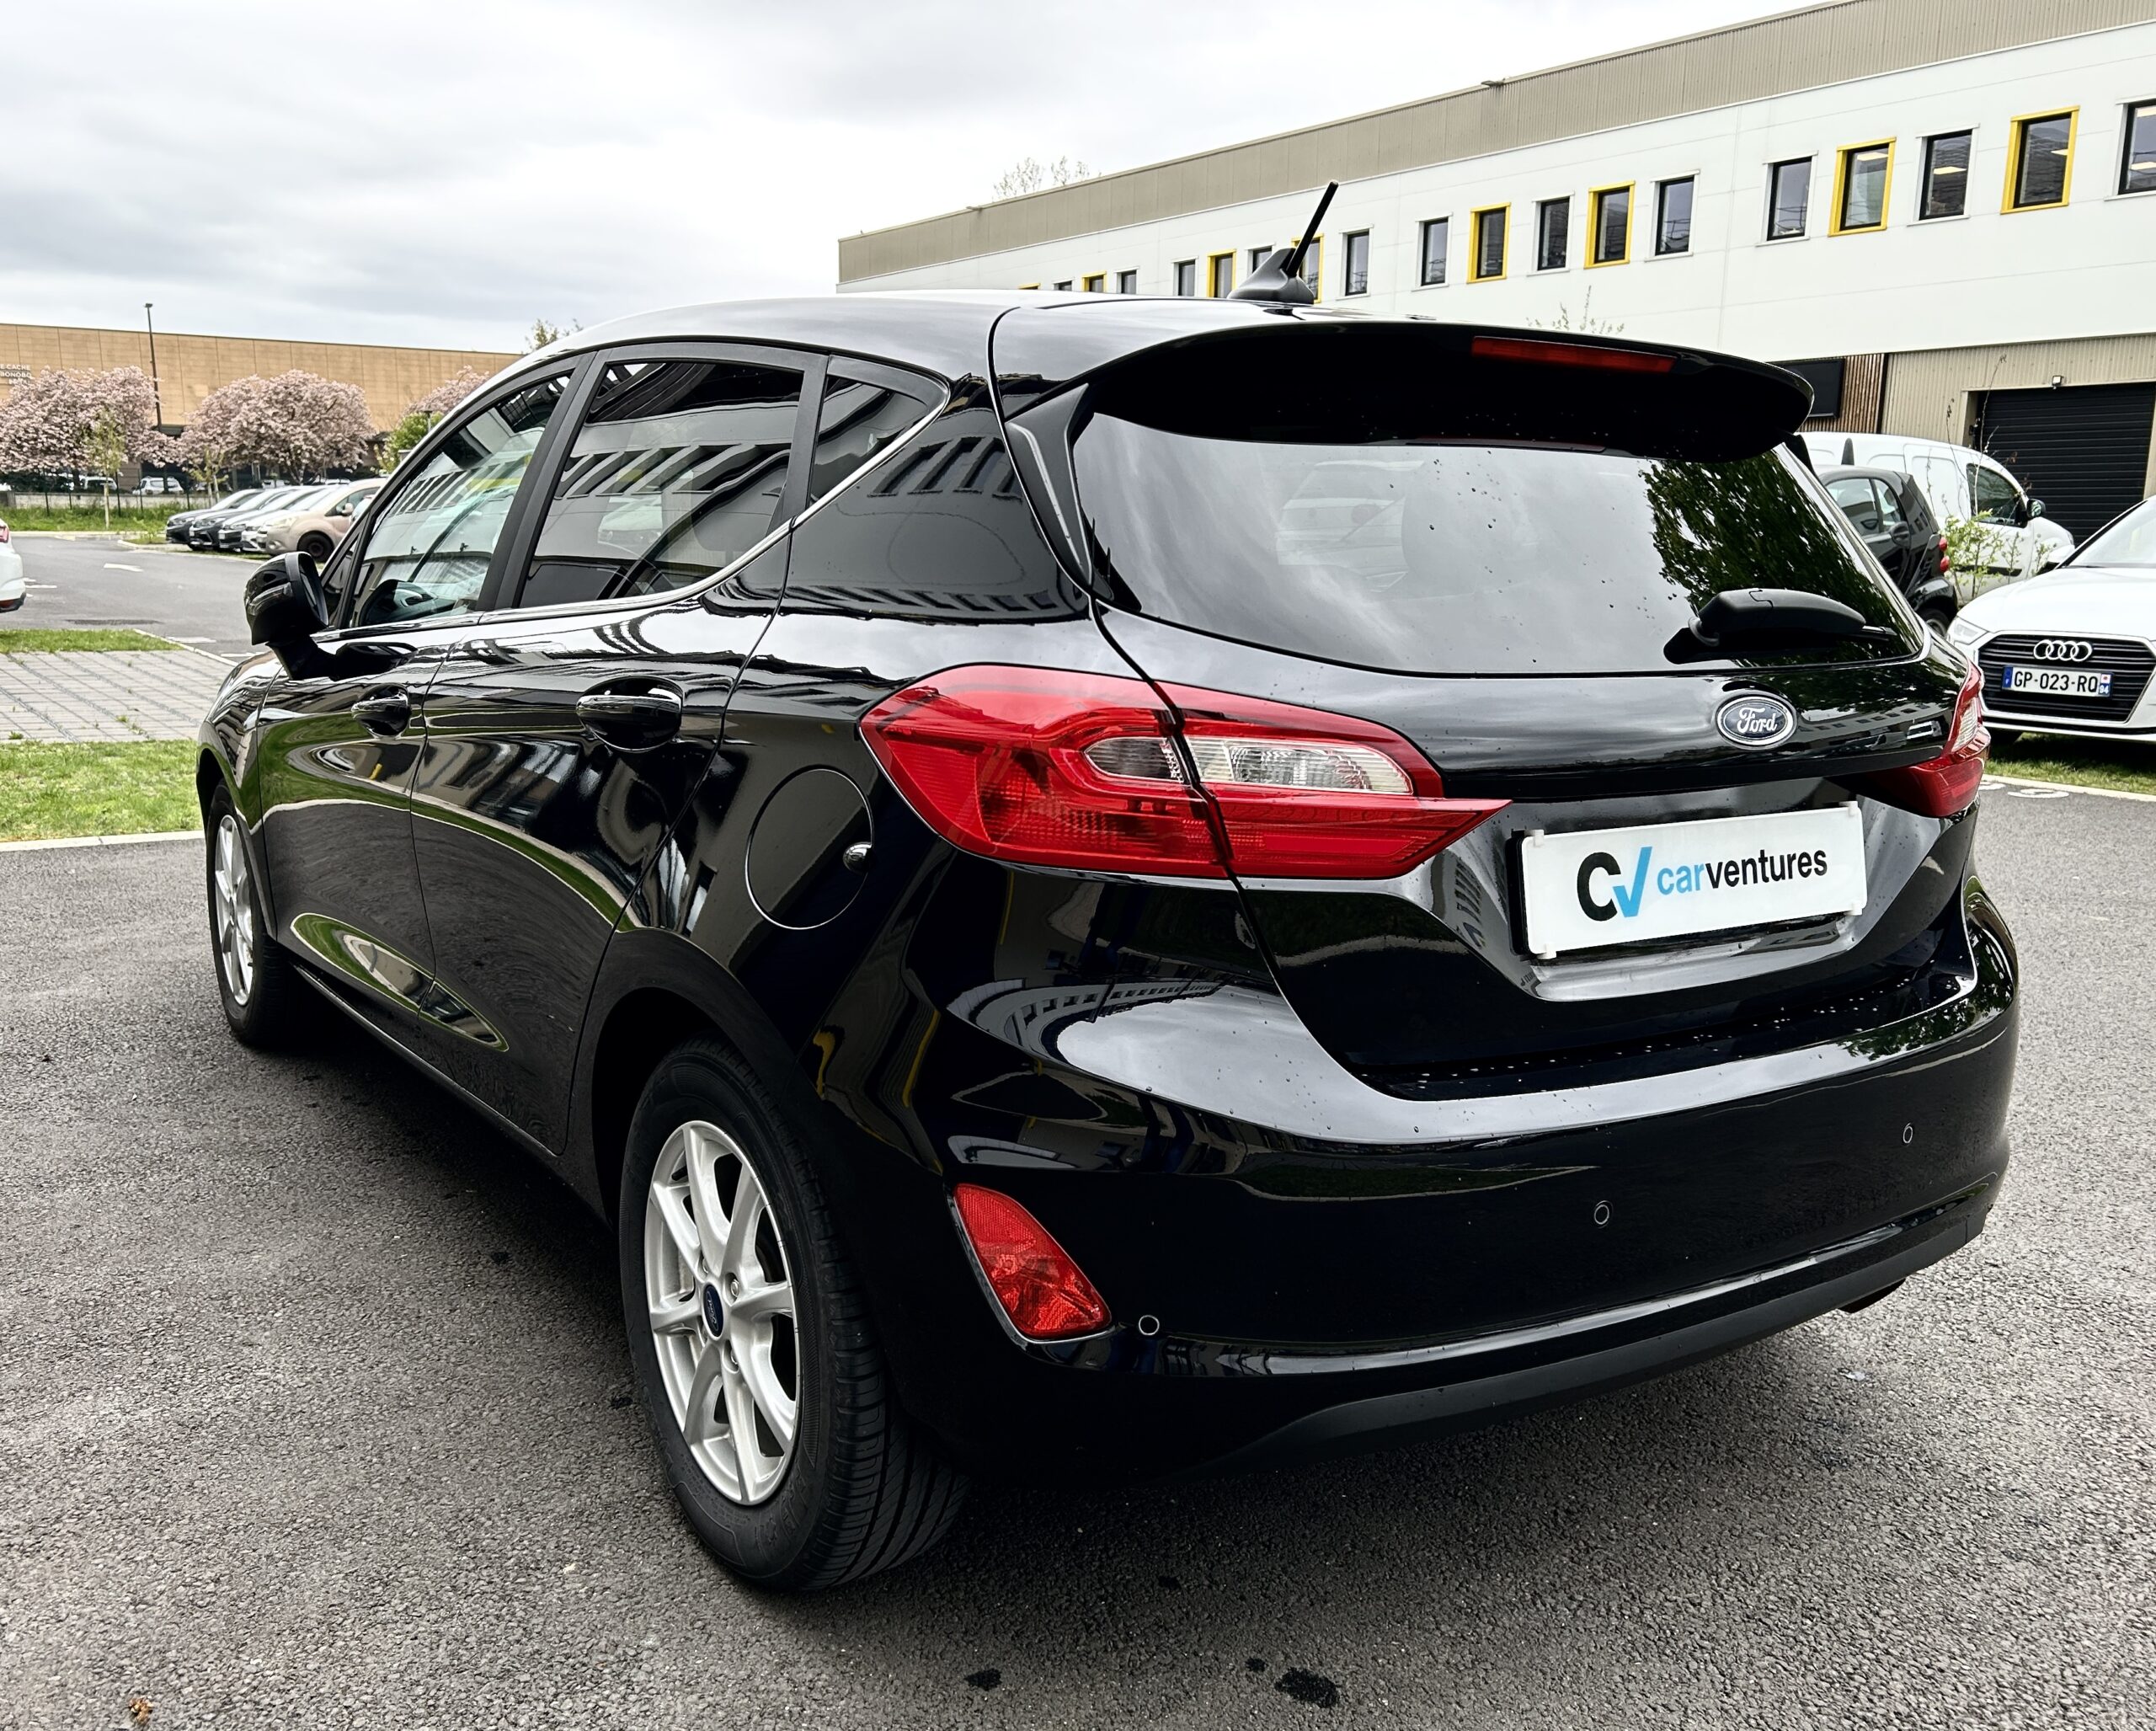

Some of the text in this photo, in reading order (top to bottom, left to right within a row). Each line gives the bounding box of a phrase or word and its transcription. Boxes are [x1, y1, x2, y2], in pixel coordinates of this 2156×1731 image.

[2014, 670, 2098, 693] GP-023-RQ
[1737, 707, 1778, 733] Ford
[1657, 848, 1828, 895] carventures
